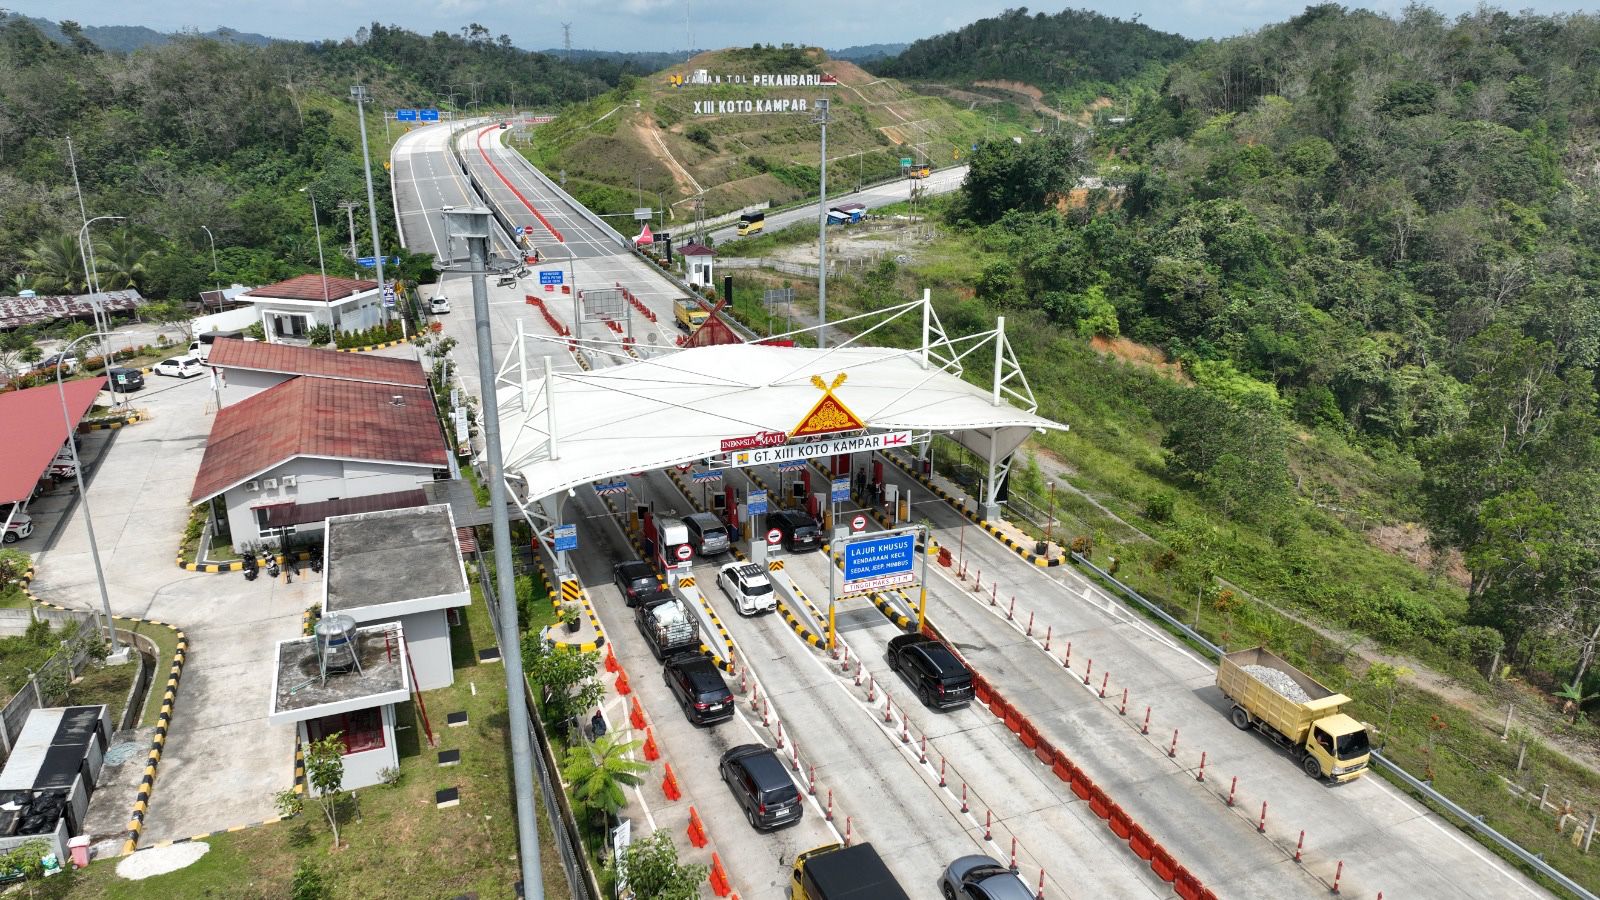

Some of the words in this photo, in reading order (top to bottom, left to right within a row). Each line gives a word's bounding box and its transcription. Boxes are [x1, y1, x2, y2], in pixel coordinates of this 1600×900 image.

[684, 75, 720, 84] JAAN
[727, 75, 747, 83] TOL
[753, 74, 821, 86] PEKANBARU
[694, 100, 714, 114] XIII
[719, 100, 752, 113] KOTO
[756, 99, 807, 112] KAMPAR
[759, 434, 785, 446] MAJU
[754, 451, 771, 463] GT.
[775, 447, 794, 460] XIII
[798, 444, 829, 457] KOTO
[833, 437, 880, 451] KAMPAR
[851, 546, 875, 556] LAJUR
[878, 542, 908, 552] KHUSUS
[853, 554, 888, 564] KENDARAAN
[886, 560, 908, 568] MINIBUS
[850, 582, 871, 590] TINGGI
